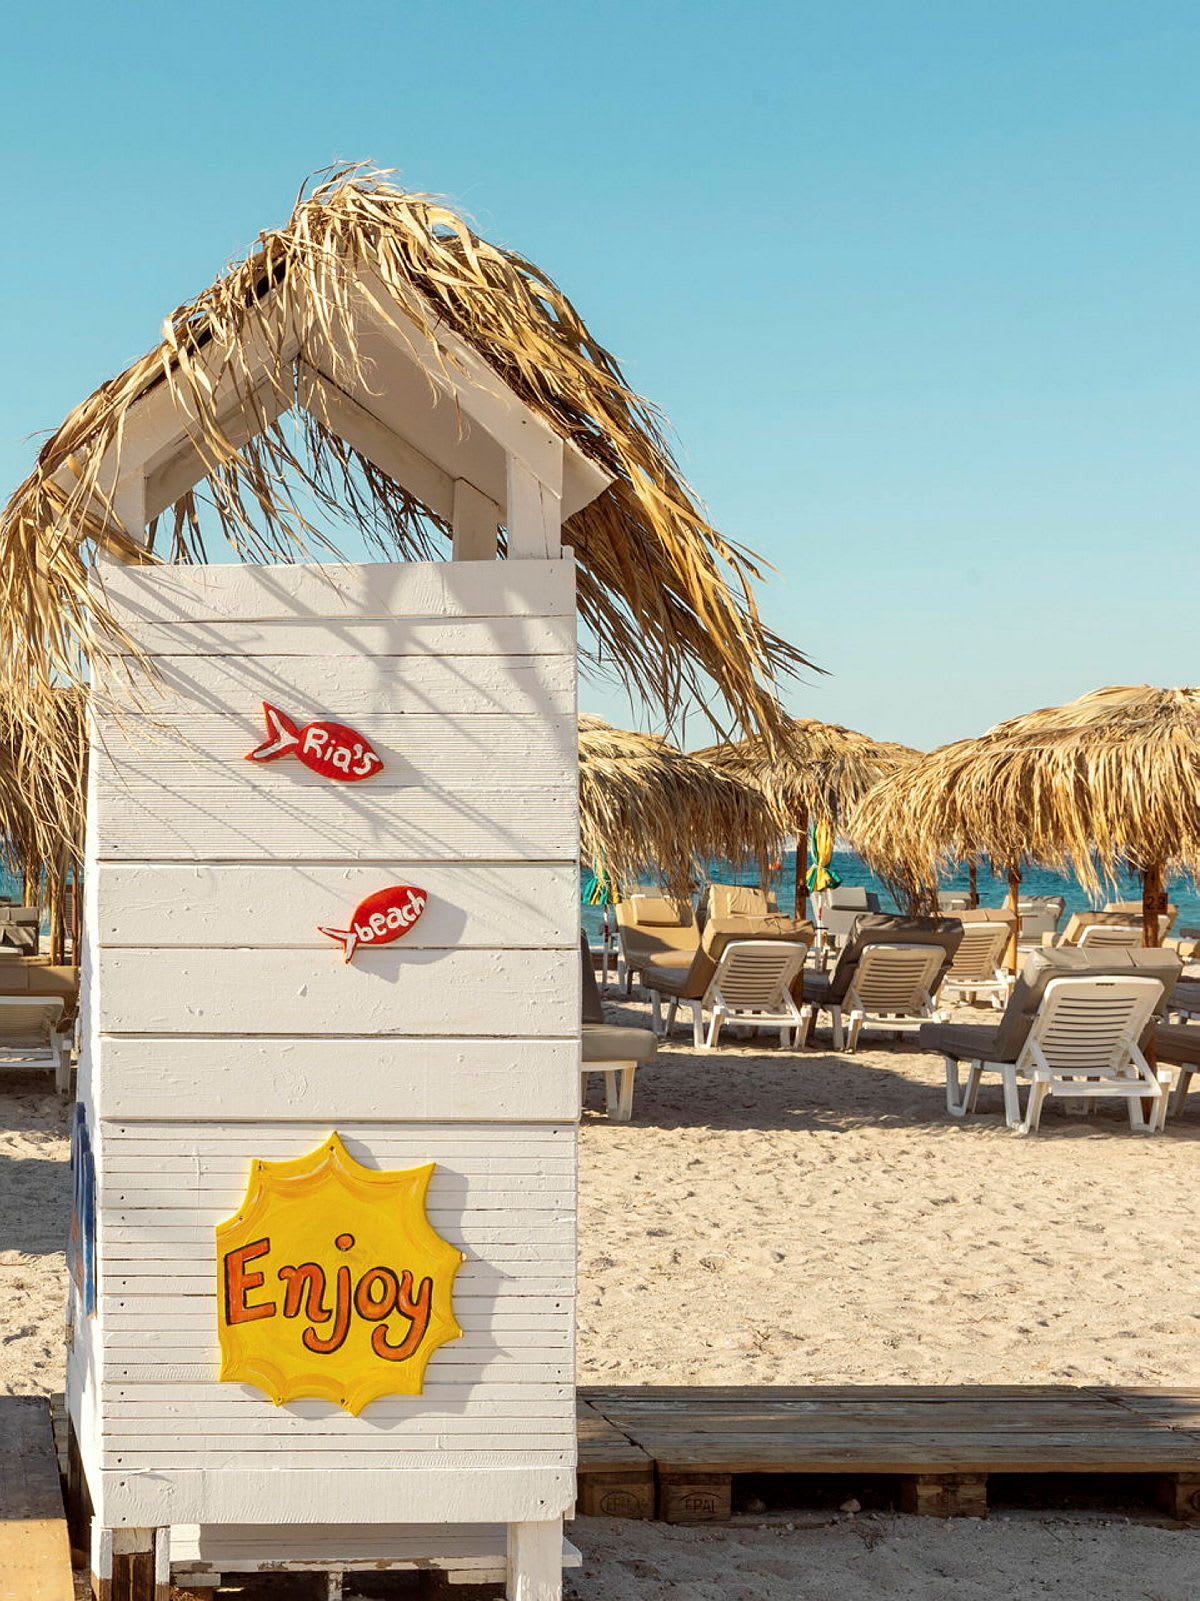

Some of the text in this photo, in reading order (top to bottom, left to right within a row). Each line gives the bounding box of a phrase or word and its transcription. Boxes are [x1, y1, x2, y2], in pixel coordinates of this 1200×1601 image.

[302, 727, 381, 775] Ria's
[353, 889, 427, 942] beach
[224, 1233, 433, 1362] Enjoy
